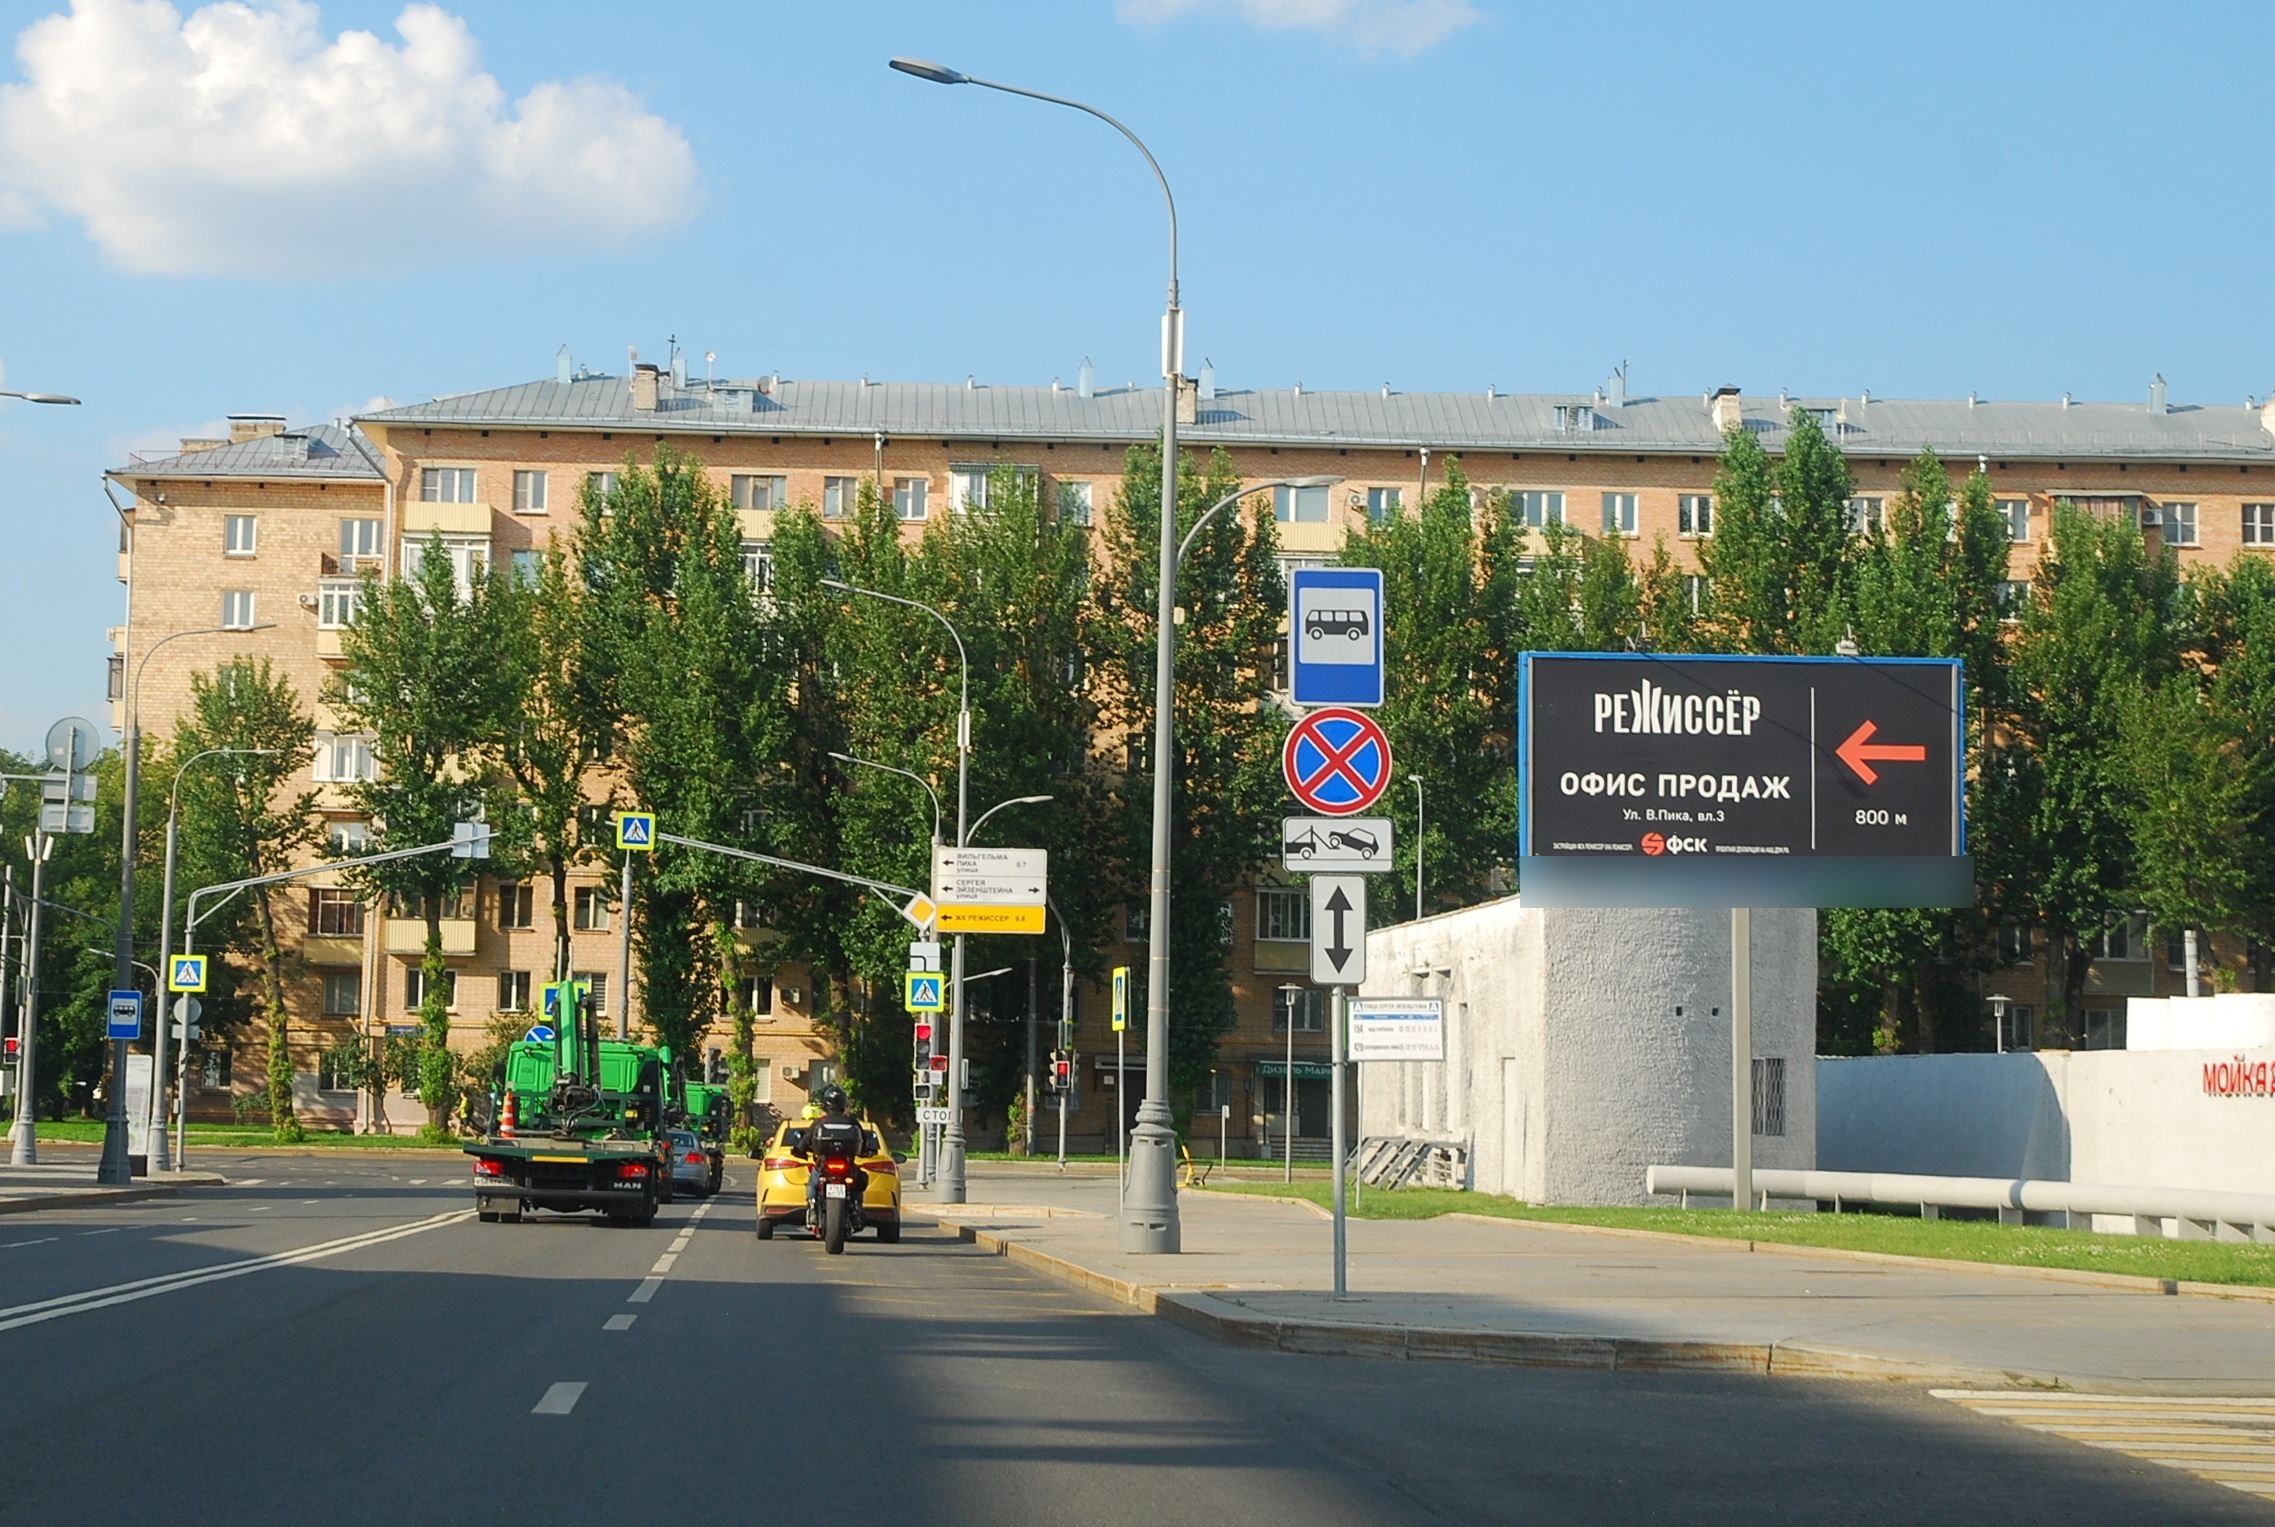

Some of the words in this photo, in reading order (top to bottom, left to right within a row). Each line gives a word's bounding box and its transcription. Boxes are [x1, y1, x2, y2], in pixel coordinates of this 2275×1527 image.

[1594, 678, 1761, 736] РЕЖИССЁР
[1560, 771, 1646, 797] ОФИС
[1658, 773, 1791, 803] ПРОДАЖ
[1622, 808, 1642, 822] Ул.
[1645, 808, 1693, 824] В.Пика,
[1697, 810, 1726, 823] вл.3
[1855, 809, 1889, 826] 800
[1894, 813, 1907, 826] м
[956, 886, 1013, 894] ЭЙЗЕНШТЕЙНА
[2203, 1053, 2267, 1093] МОЙКА
